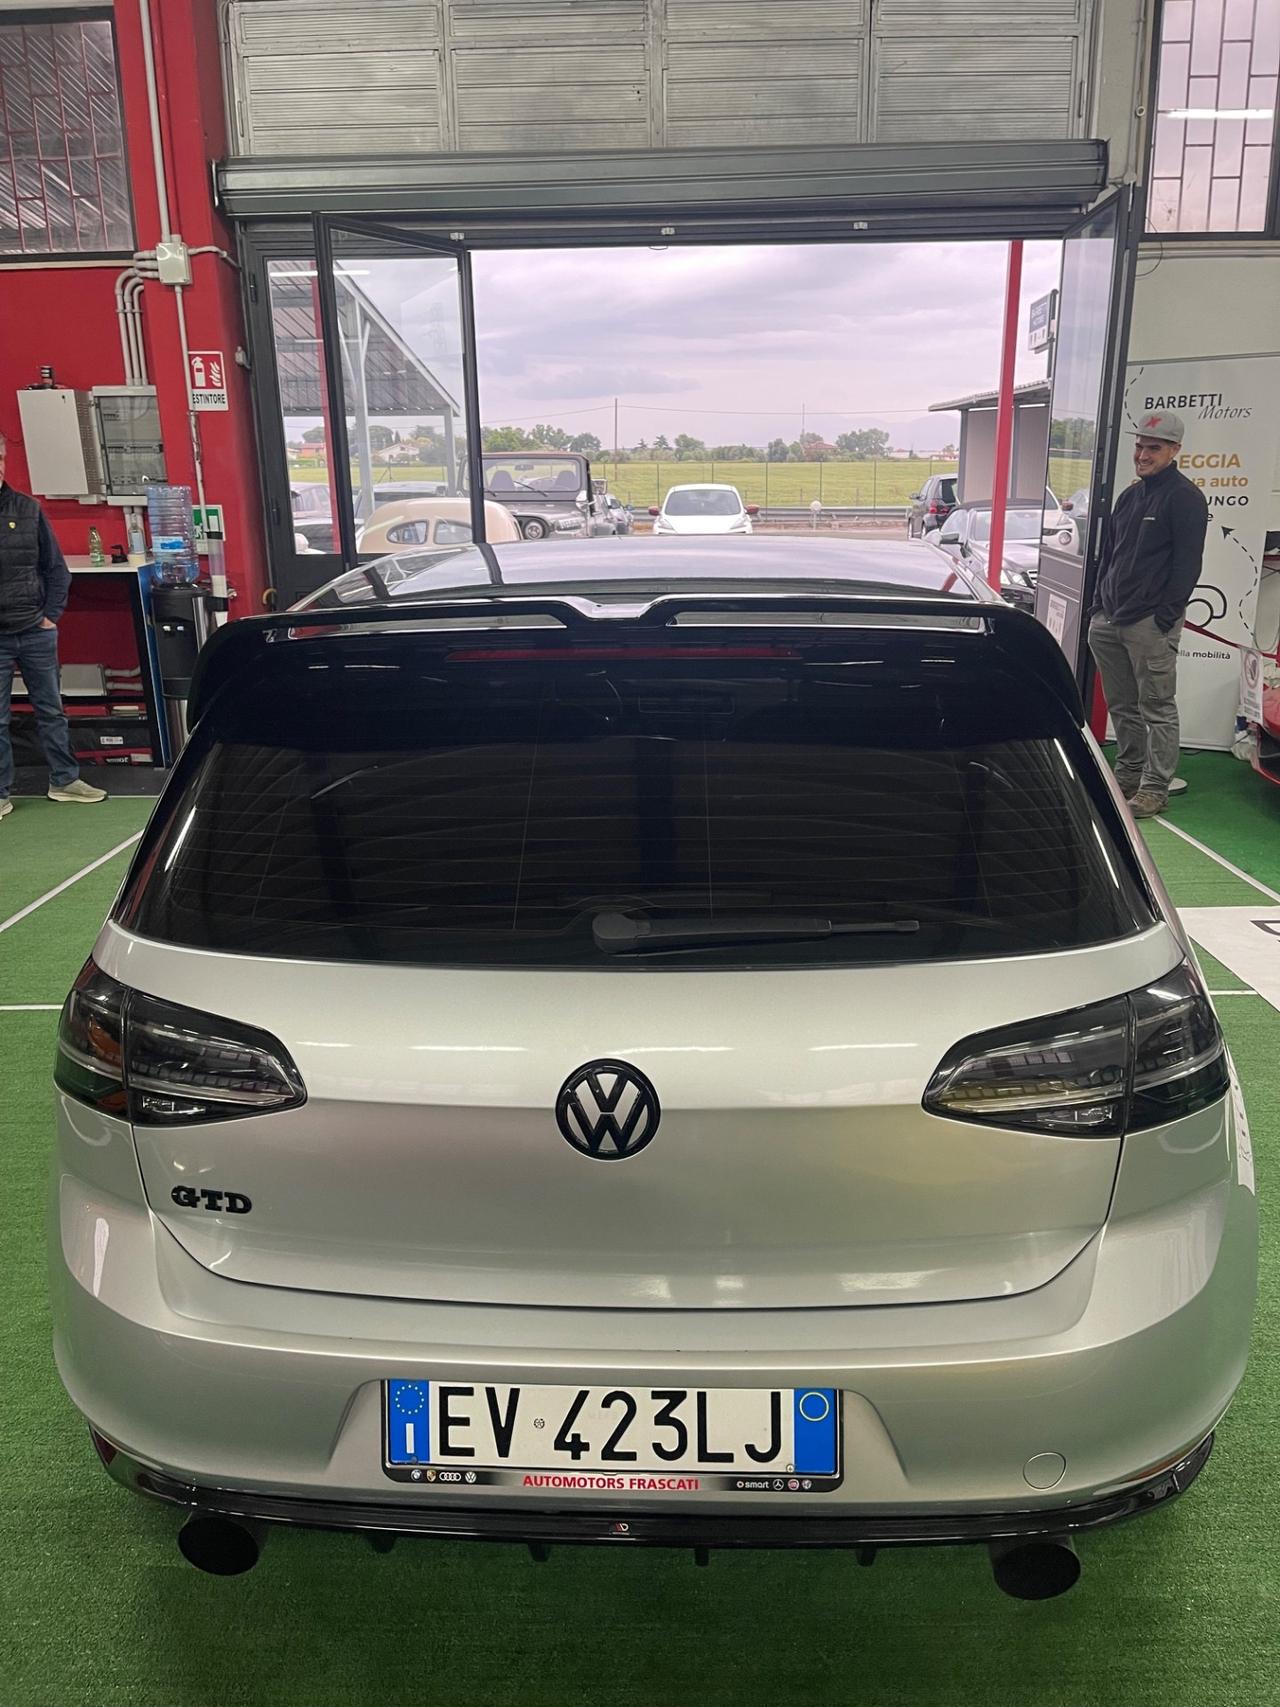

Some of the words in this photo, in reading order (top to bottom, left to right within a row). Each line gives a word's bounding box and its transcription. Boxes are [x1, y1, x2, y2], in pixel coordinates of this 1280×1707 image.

[192, 393, 226, 405] ESTINTORE
[1144, 394, 1223, 410] BARBETTI
[1198, 405, 1253, 420] Motors
[1178, 453, 1241, 469] EGGIA
[1210, 475, 1249, 488] auto
[1206, 495, 1249, 506] UNGO
[1192, 651, 1231, 660] mobilità
[171, 1185, 252, 1214] GTD
[438, 1386, 521, 1459] EV
[553, 1389, 782, 1463] 423LJ
[523, 1475, 625, 1490] AUTOMOTORS
[629, 1478, 699, 1490] FRASCATI
[745, 1480, 769, 1489] smart
